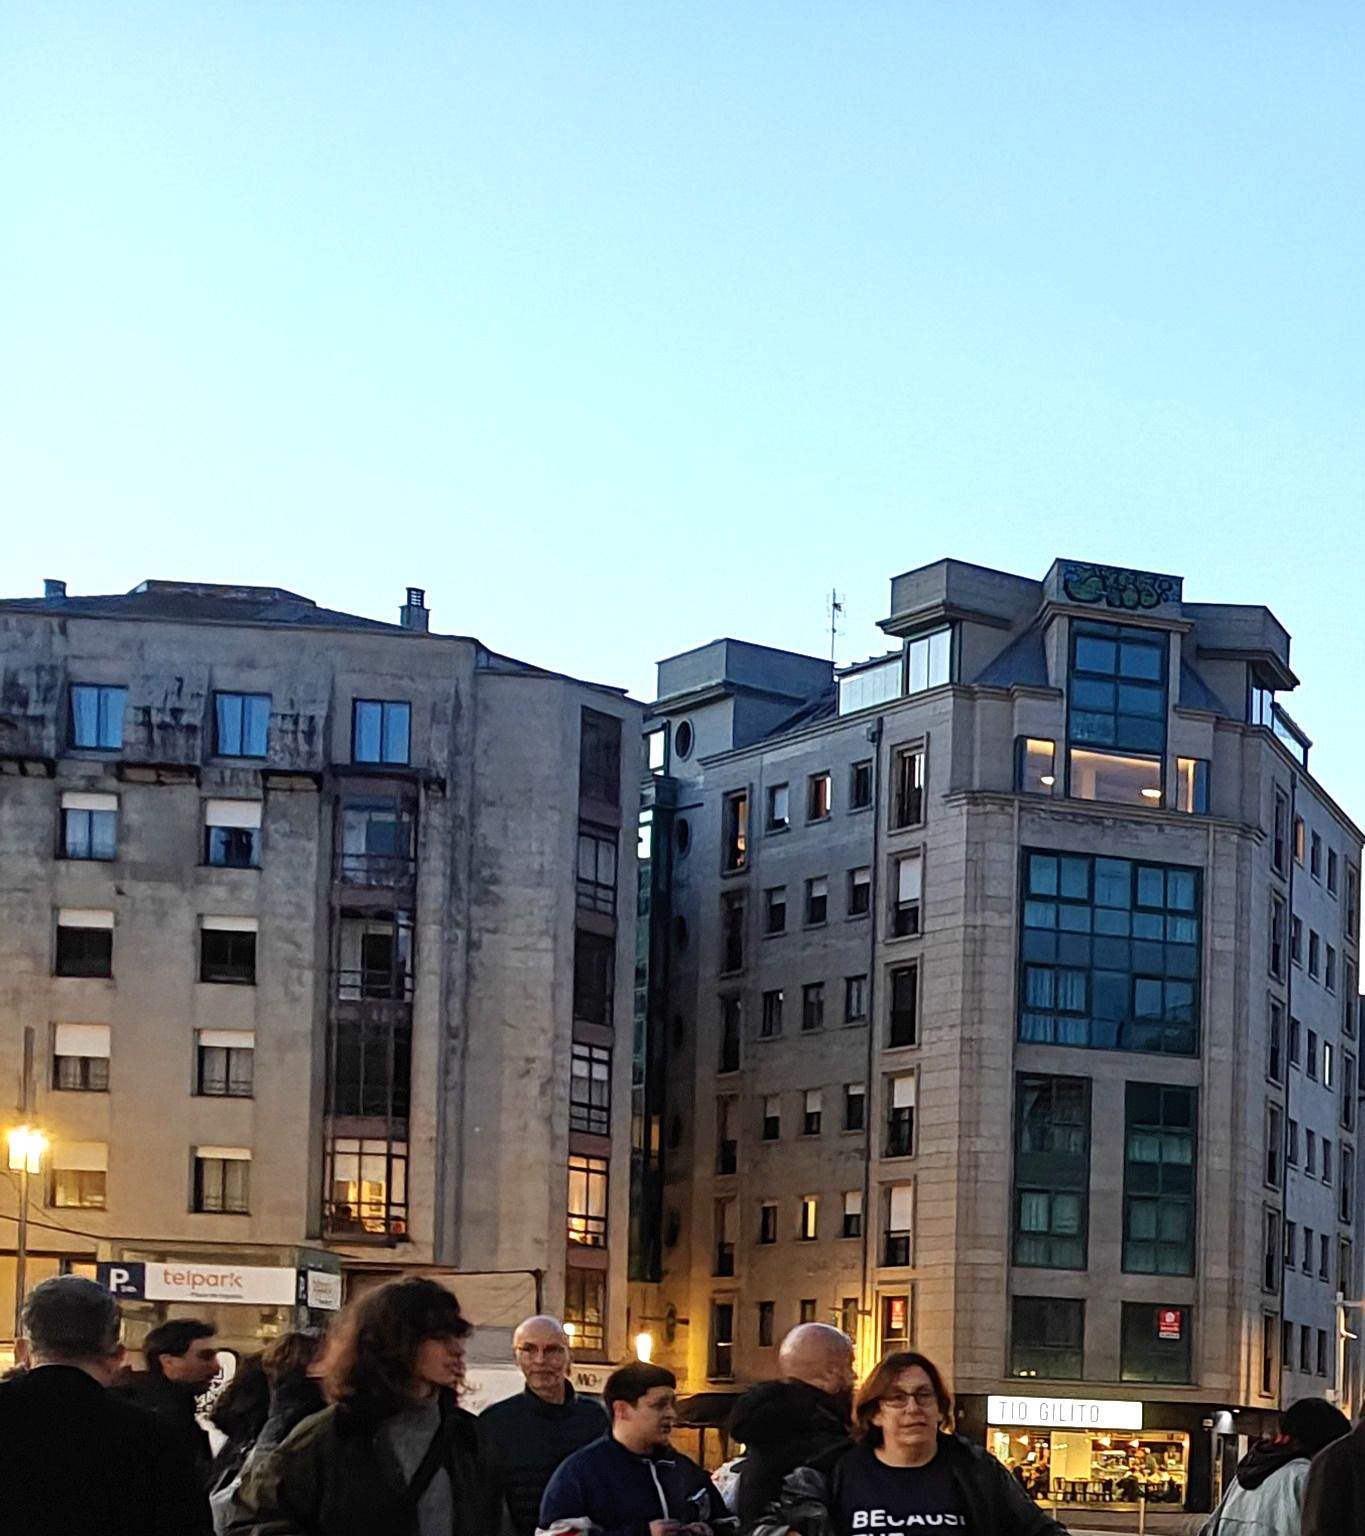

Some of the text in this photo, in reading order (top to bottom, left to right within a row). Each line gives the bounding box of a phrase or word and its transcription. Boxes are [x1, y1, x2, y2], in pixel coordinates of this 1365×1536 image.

[109, 1268, 130, 1292] P
[163, 1269, 243, 1290] telpark
[999, 1401, 1100, 1423] TIO GILITO
